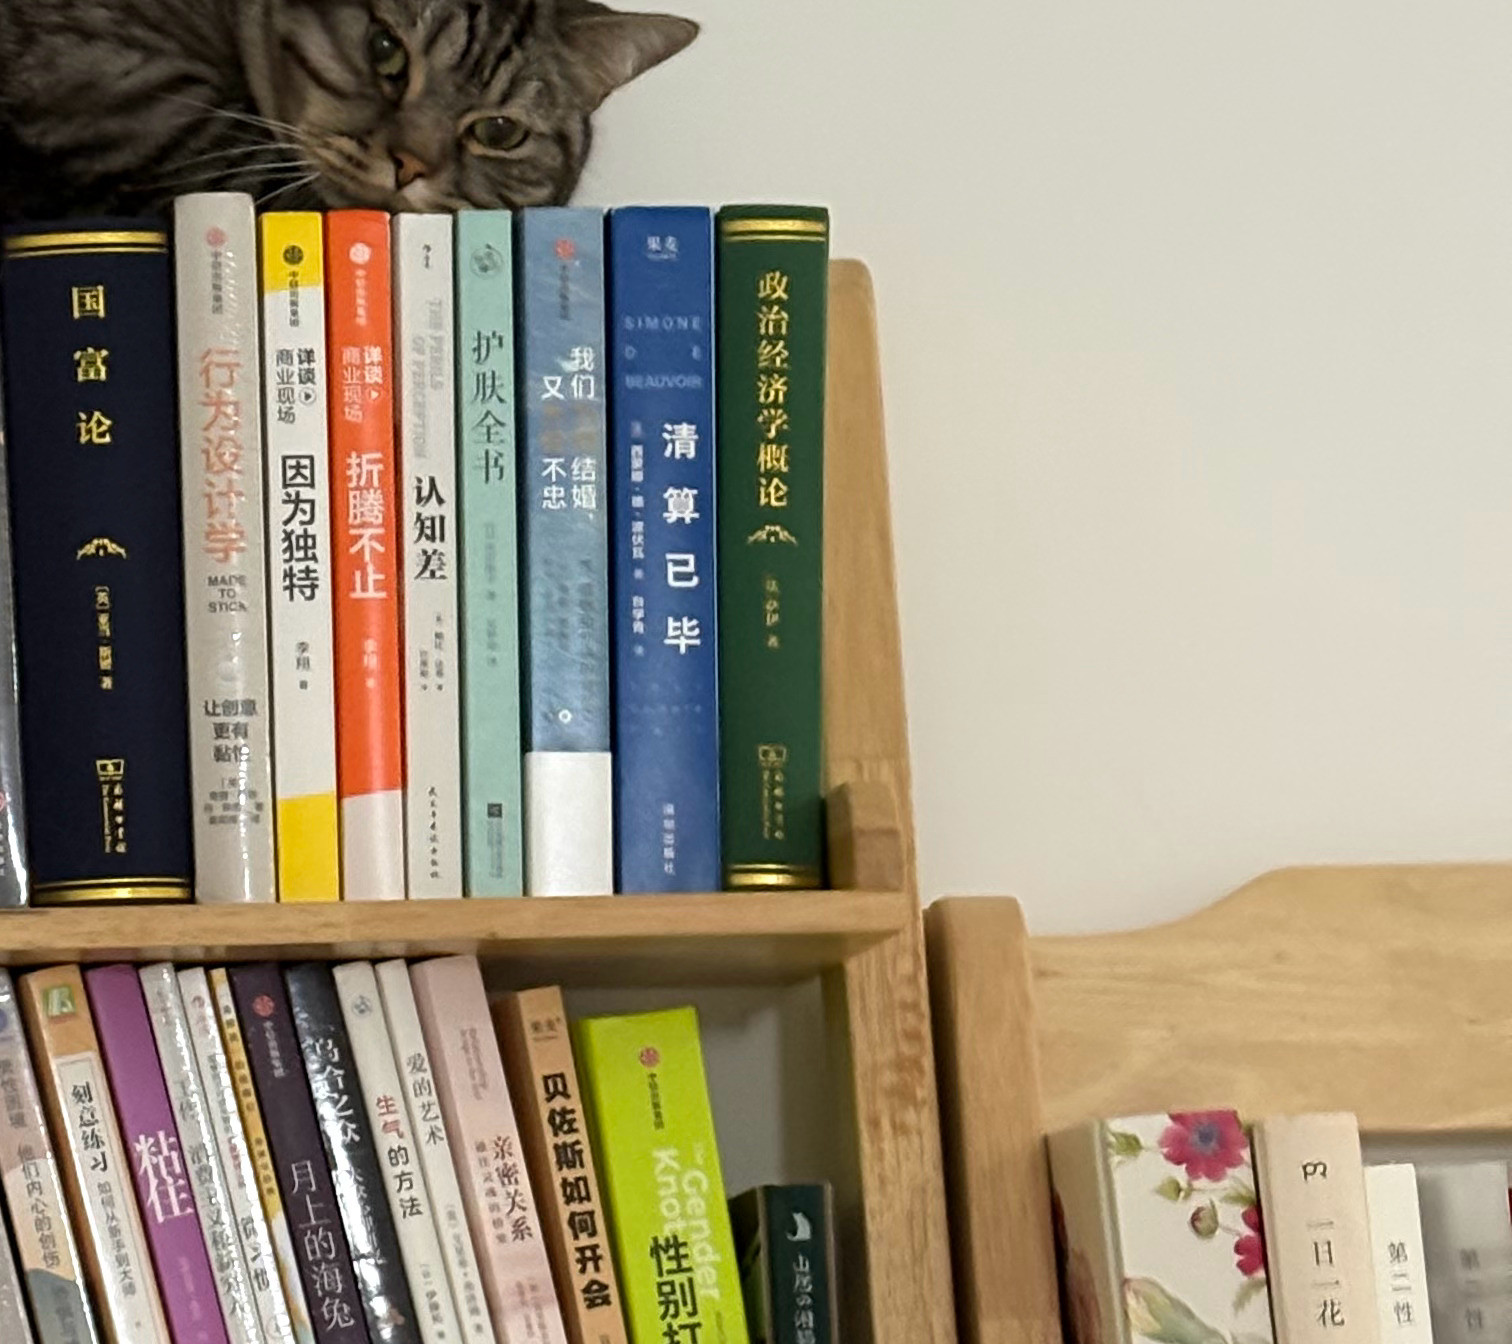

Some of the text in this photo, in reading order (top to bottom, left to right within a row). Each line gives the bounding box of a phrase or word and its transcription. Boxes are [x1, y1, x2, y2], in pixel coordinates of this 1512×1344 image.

[71, 284, 114, 447] 国富论
[296, 347, 317, 387] 详谈
[363, 345, 384, 386] 详谈
[624, 315, 701, 331] SIMONE
[275, 348, 297, 425] 商业现场
[341, 346, 364, 423] 商业现场
[471, 328, 507, 484] 护肤全书
[570, 346, 595, 401] 我们
[624, 375, 702, 390] BEAUVOIR
[756, 270, 789, 508] 政治经济学概论
[199, 346, 247, 564] 行为设计学
[540, 376, 567, 511] 又 不忠
[280, 454, 321, 602] 因为独特
[345, 450, 388, 600] 折腾不止
[412, 475, 448, 581] 认知差
[661, 421, 701, 655] 清算已毕
[219, 588, 237, 600] TO
[203, 698, 258, 718] 让创意
[212, 720, 250, 740] 更有
[71, 1080, 109, 1173] 刻意练习
[405, 1052, 445, 1146] 爱的艺术
[374, 1094, 424, 1220] 生气的方法
[491, 1134, 534, 1242] 亲密关系
[541, 1071, 612, 1310] 贝佐斯如何开会
[652, 1145, 687, 1236] Knot
[682, 1167, 722, 1300] Gender
[1306, 1218, 1346, 1329] 一日一花
[1388, 1240, 1416, 1327] 第二性
